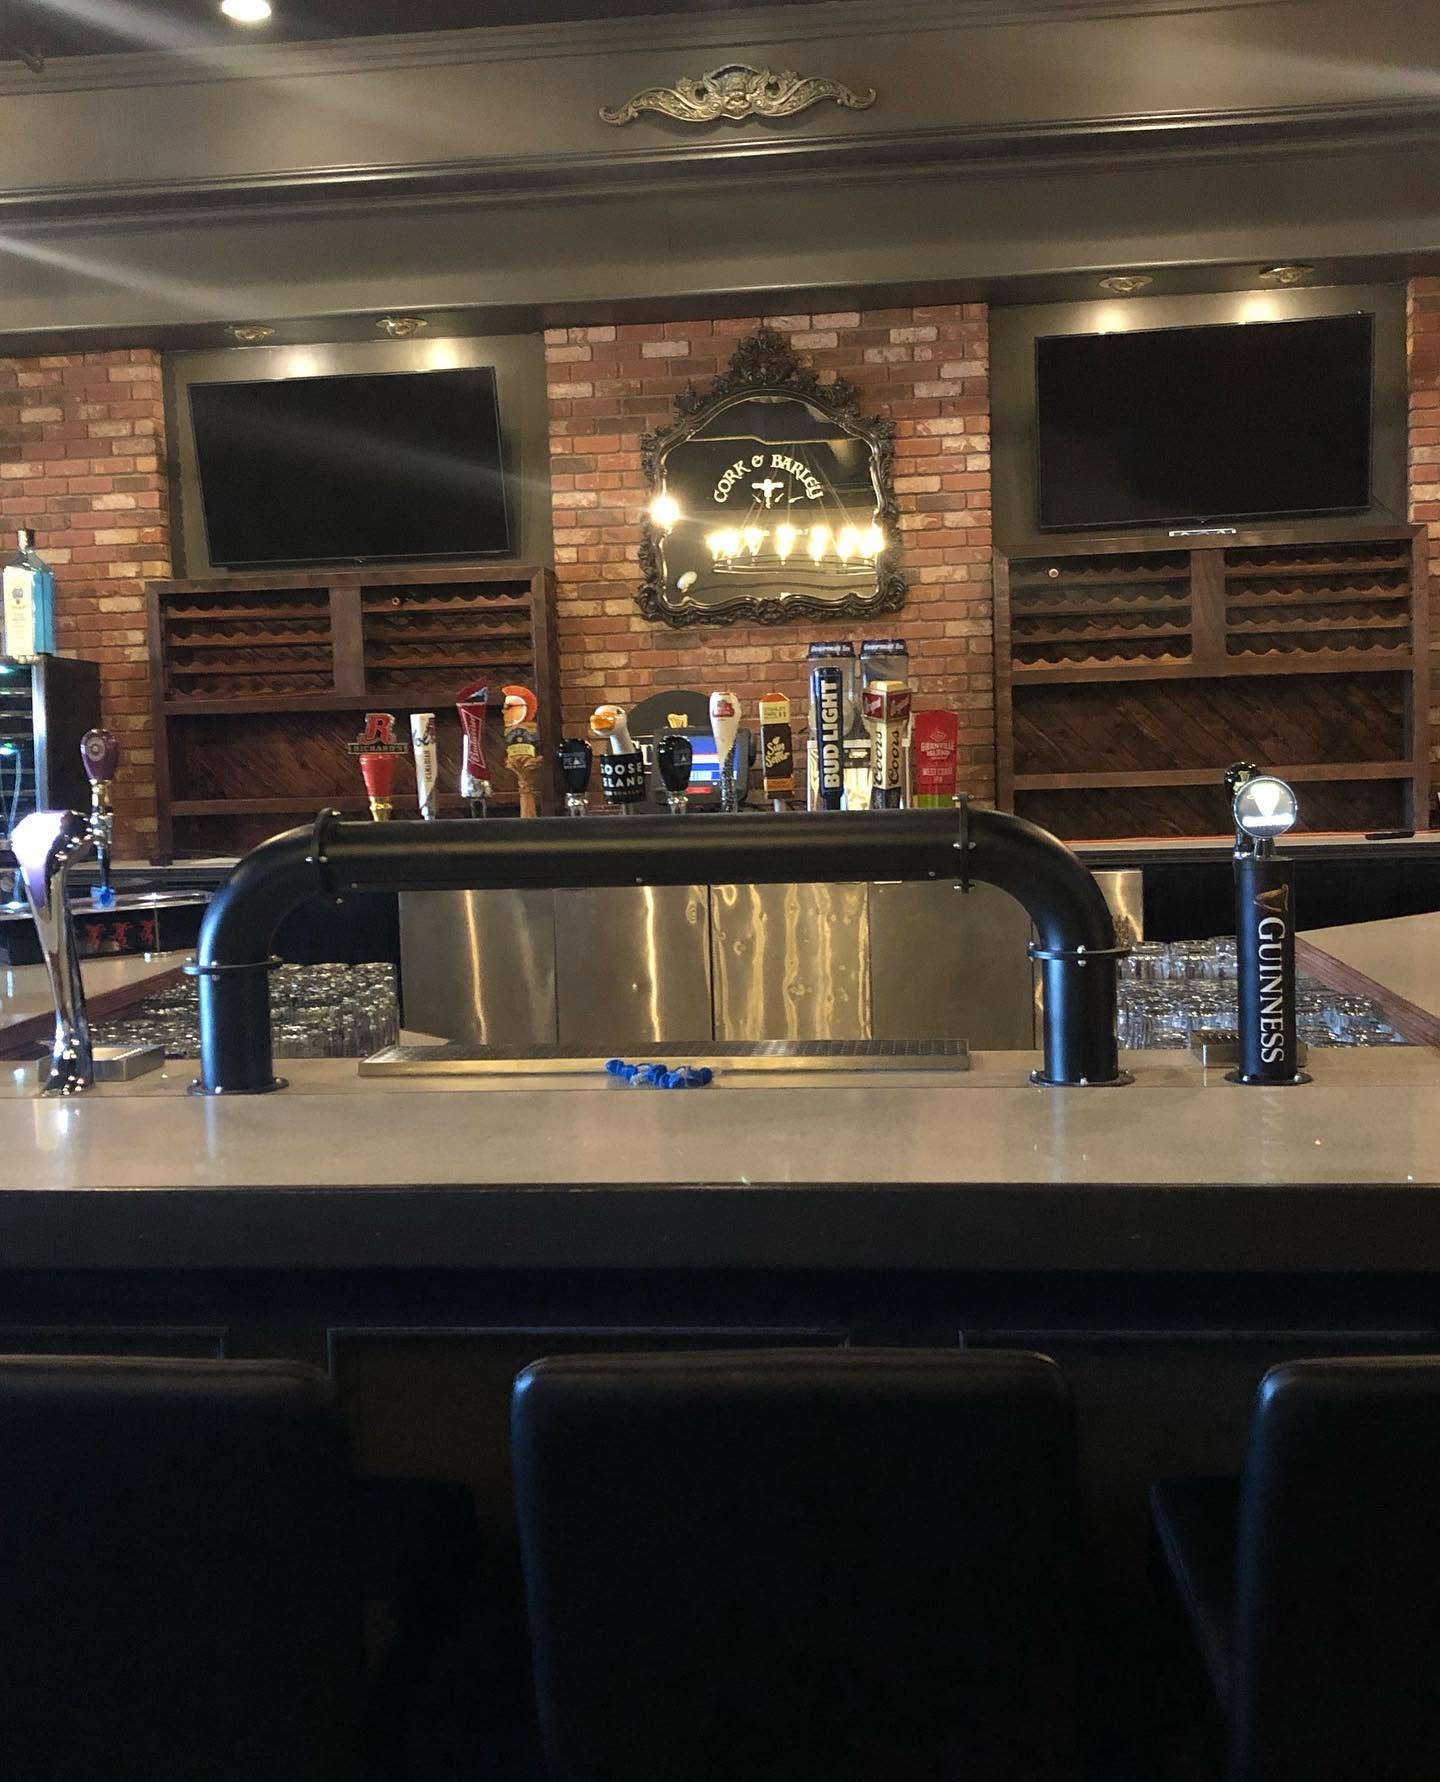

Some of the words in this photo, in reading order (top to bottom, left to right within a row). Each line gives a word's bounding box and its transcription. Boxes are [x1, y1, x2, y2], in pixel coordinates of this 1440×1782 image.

[713, 460, 751, 503] CORK
[752, 454, 764, 468] &
[771, 454, 824, 500] BARLEY
[821, 680, 839, 741] LIGHT
[823, 744, 840, 788] BUD
[874, 731, 883, 786] Coors
[889, 730, 900, 786] Coors
[1258, 916, 1287, 1064] GUINNESS
